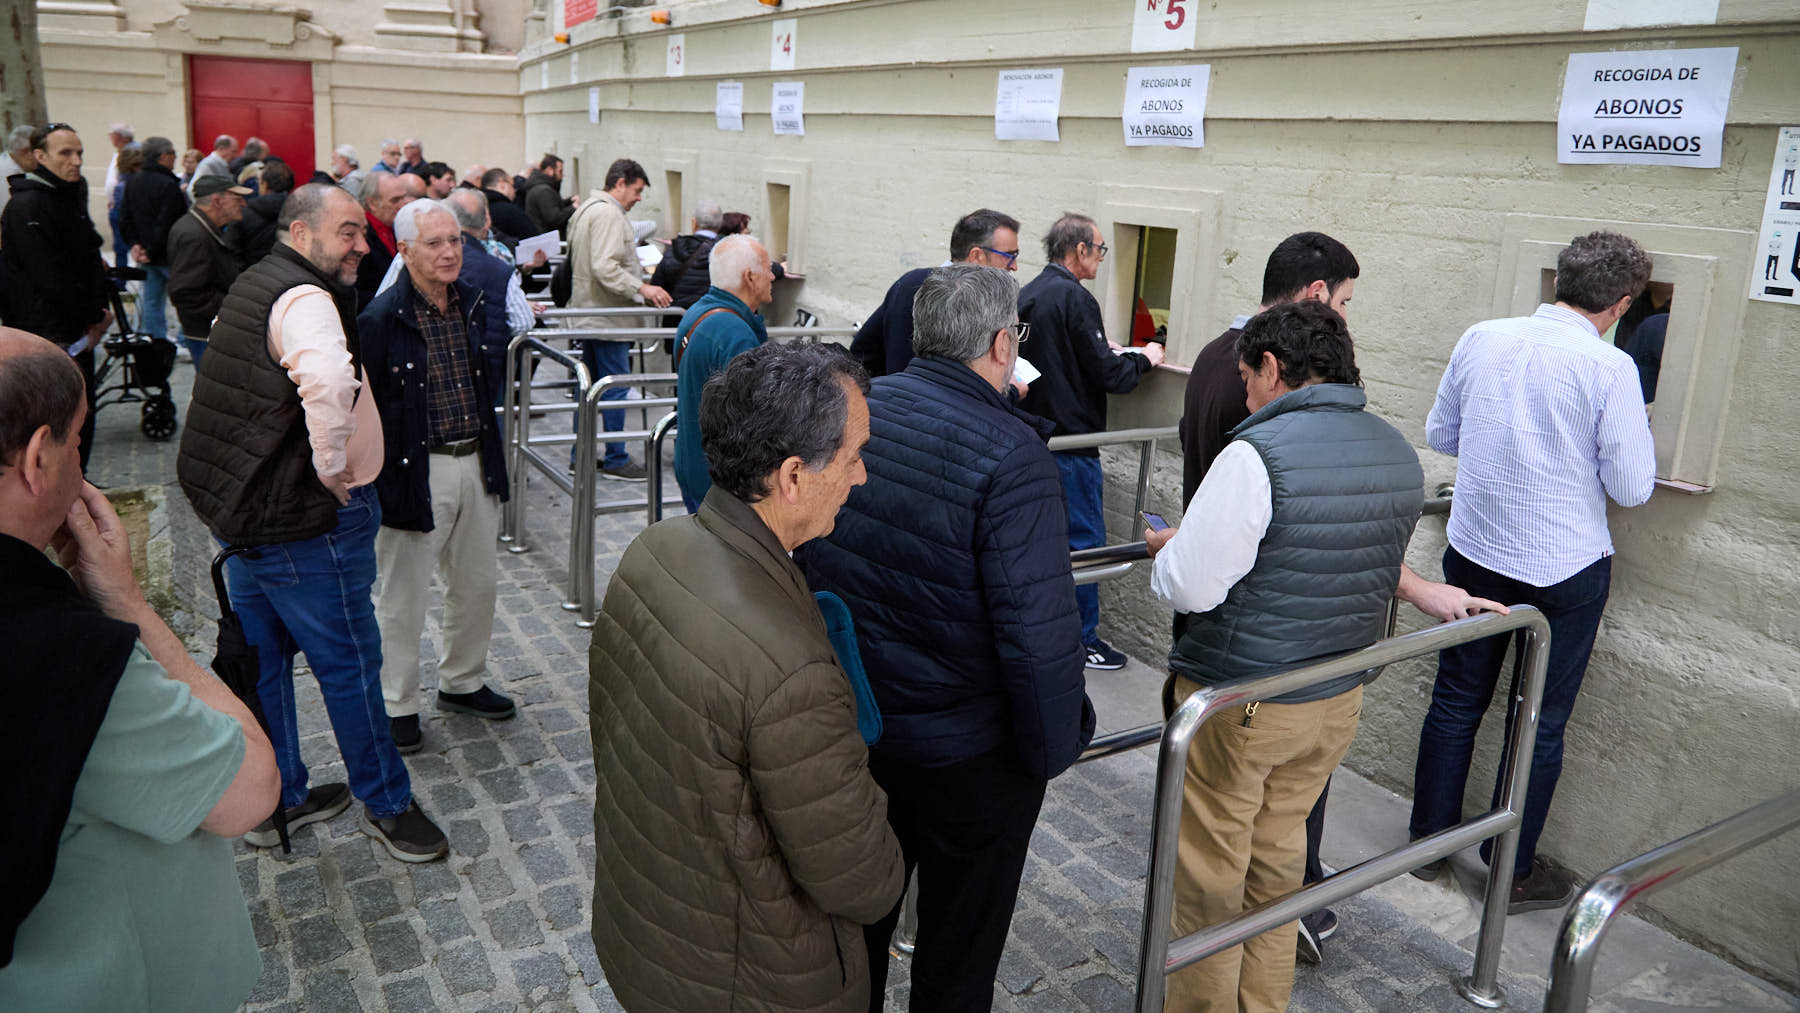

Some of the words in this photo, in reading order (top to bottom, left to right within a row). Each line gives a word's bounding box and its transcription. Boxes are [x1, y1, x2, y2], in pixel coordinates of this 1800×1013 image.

[1164, 0, 1186, 30] 5
[783, 32, 791, 56] 4
[674, 45, 681, 65] 3
[1140, 78, 1178, 88] RECOGIDA
[1181, 78, 1192, 88] DE
[1594, 68, 1672, 82] RECOGIDA
[1679, 68, 1700, 81] DE
[1141, 99, 1183, 111] ABONOS
[1595, 98, 1683, 116] ABONOS
[1130, 124, 1143, 136] YA
[1145, 124, 1193, 137] PAGADOS
[1572, 134, 1596, 150] YA
[1602, 135, 1701, 152] PAGADOS
